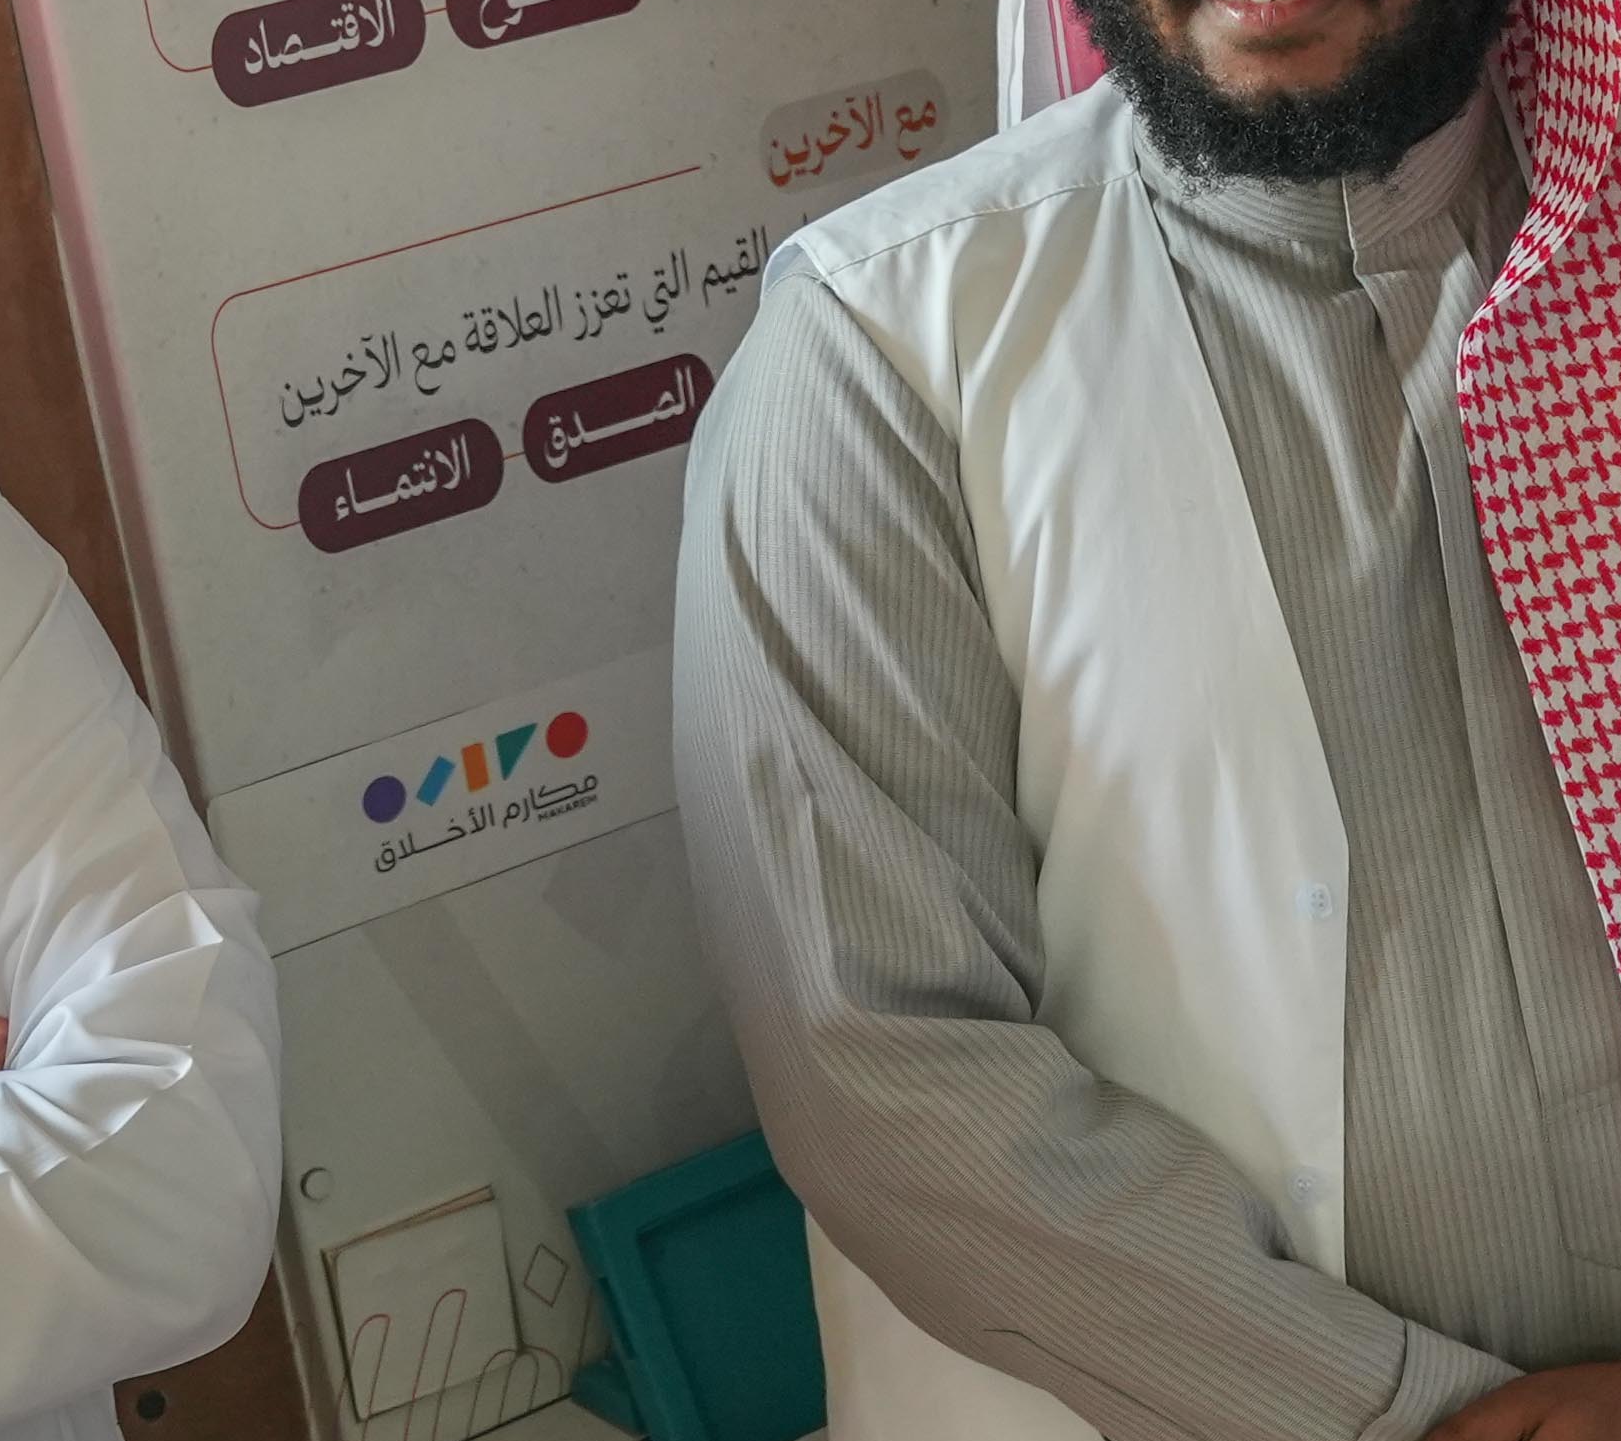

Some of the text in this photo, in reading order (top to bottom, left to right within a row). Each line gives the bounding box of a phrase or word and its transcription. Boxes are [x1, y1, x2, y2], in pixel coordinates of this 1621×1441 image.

[768, 94, 939, 188] مع الآخرين
[279, 225, 770, 427] القيم التي تعزز العلاقة مع الآخرين
[332, 364, 697, 525] الصدق الانتماء
[372, 773, 600, 874] مكارم الأخلاق
